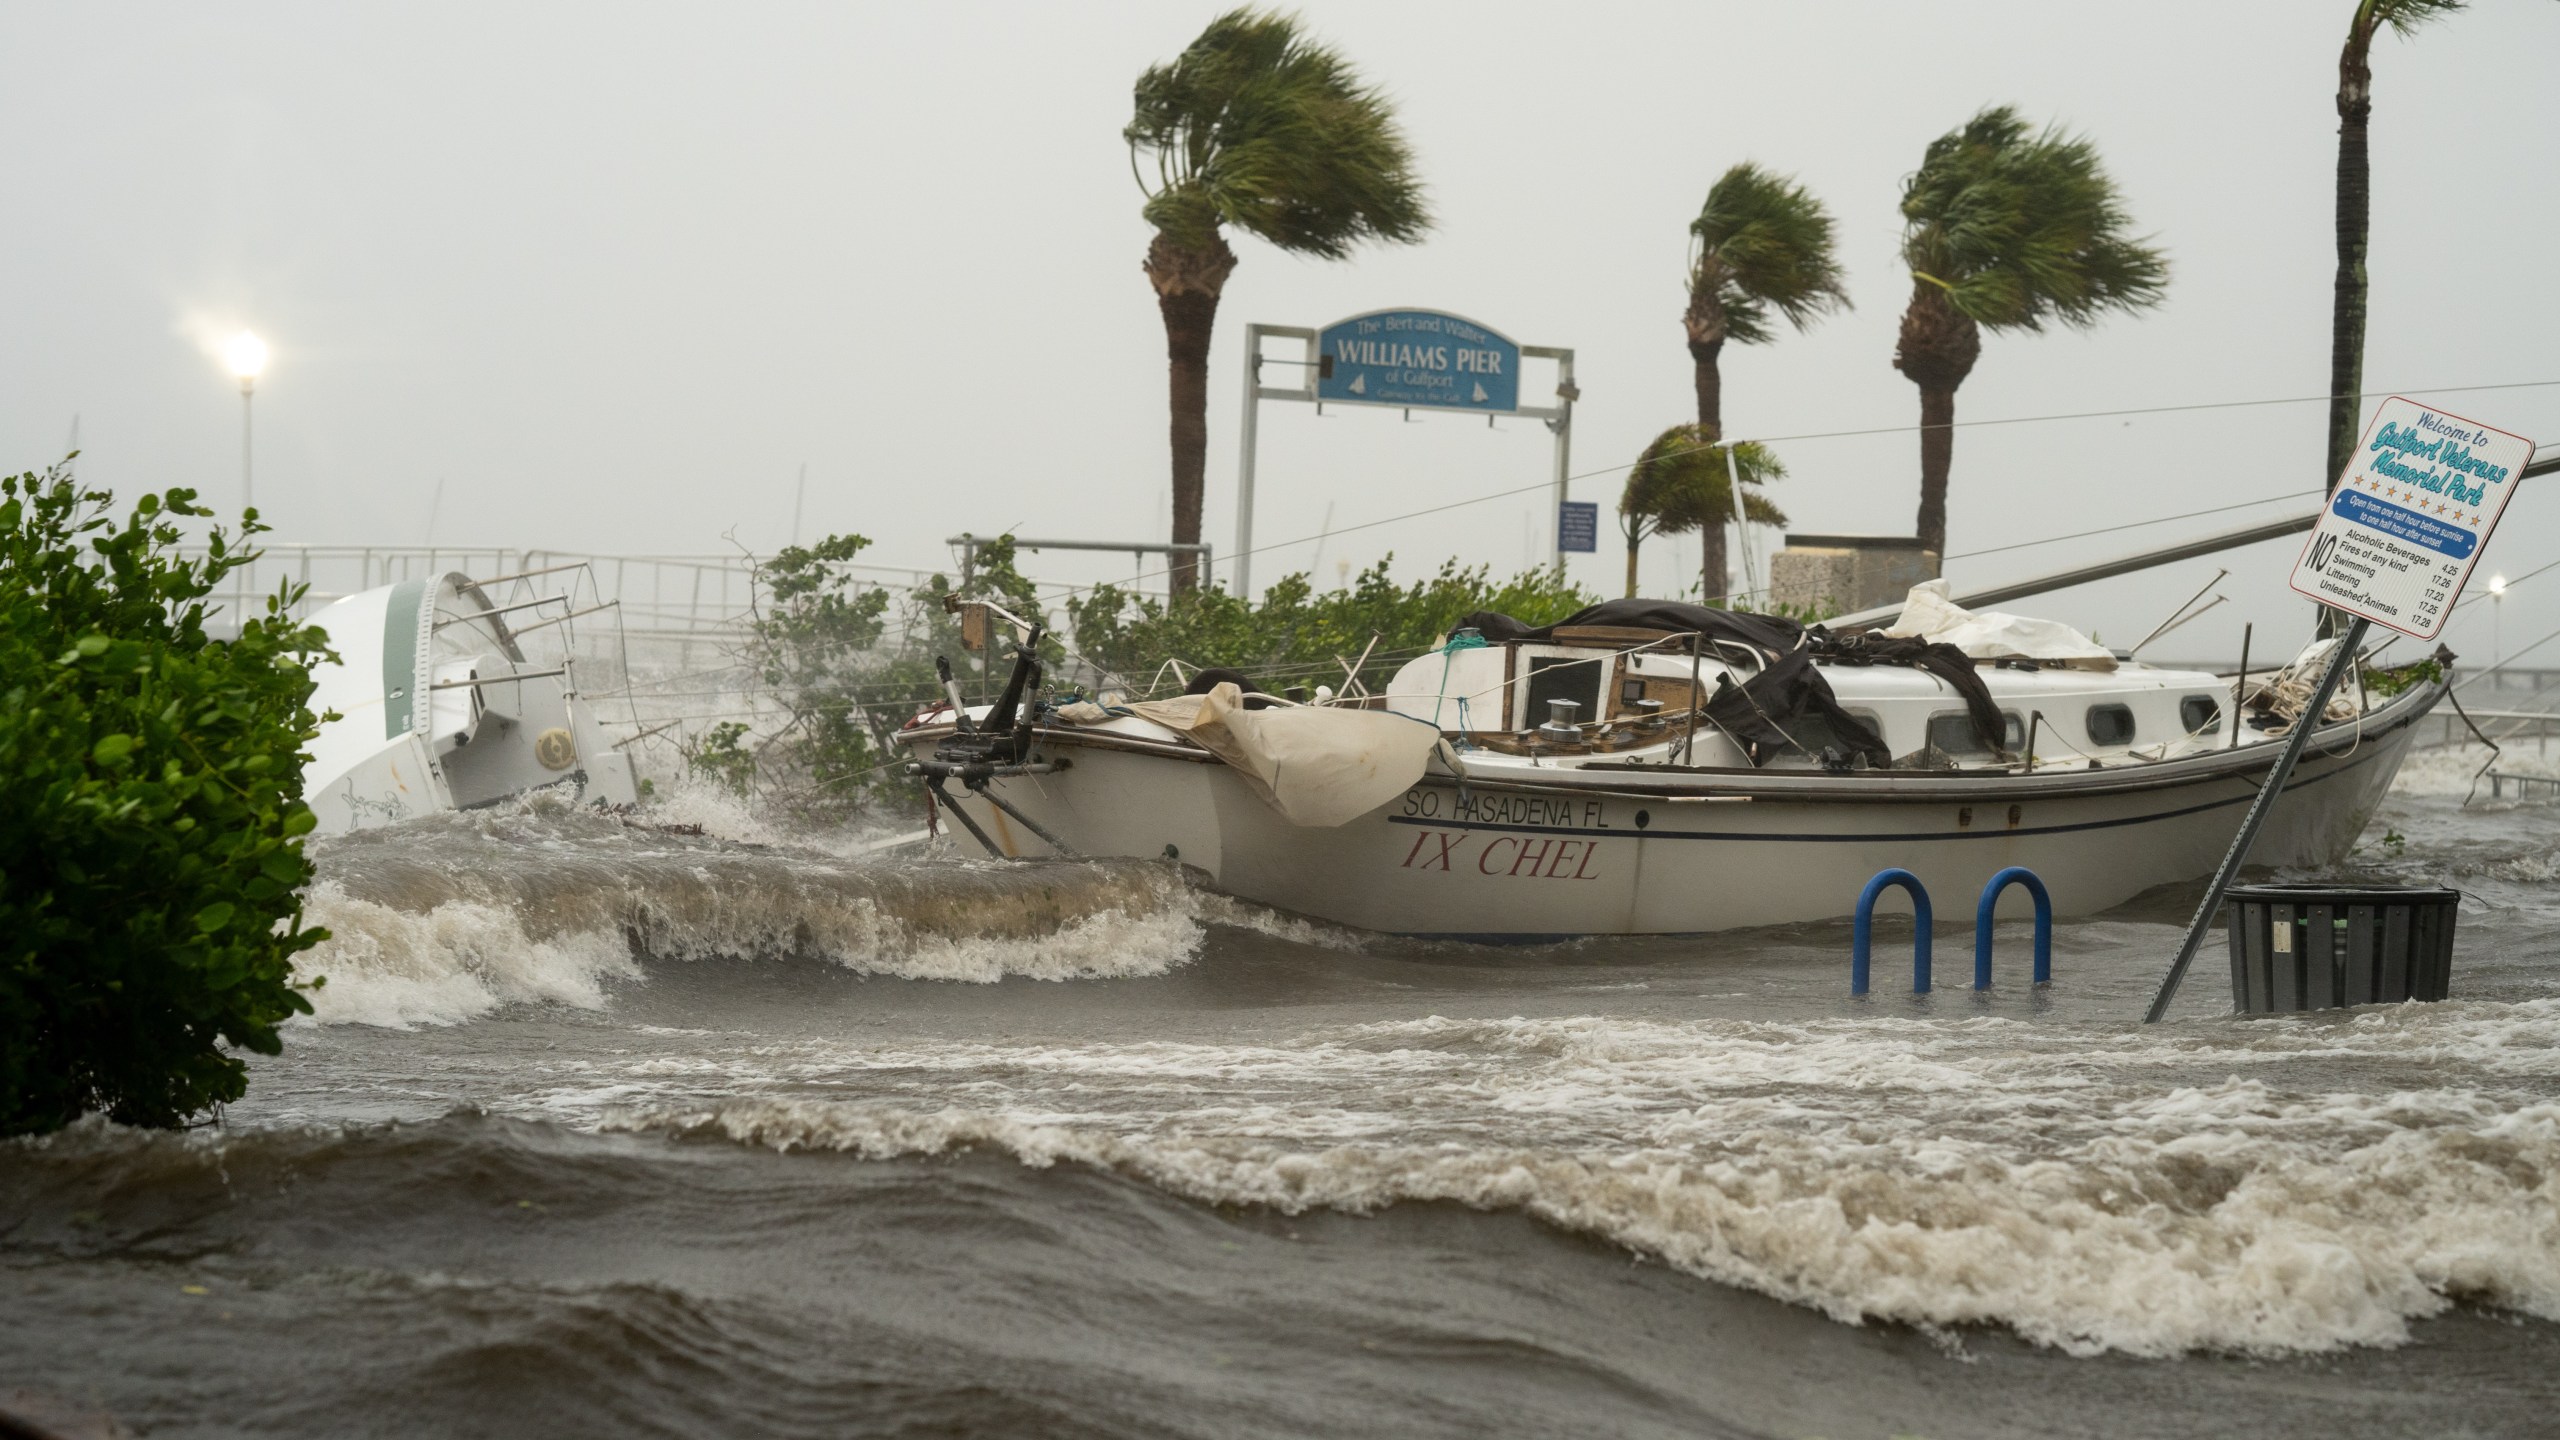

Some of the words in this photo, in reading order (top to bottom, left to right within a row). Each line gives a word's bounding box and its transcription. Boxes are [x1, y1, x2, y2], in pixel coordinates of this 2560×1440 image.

[1358, 320, 1380, 335] The
[1386, 317, 1412, 331] Bert
[1415, 319, 1440, 332] and
[1444, 321, 1486, 344] Walter
[1337, 338, 1448, 371] WILLIAMS
[1456, 348, 1502, 374] PIER
[1386, 369, 1399, 383] of
[1404, 369, 1453, 388] Gulfport
[2371, 421, 2444, 460] Gulfport
[2439, 441, 2508, 483] Veterans
[2417, 411, 2471, 441] Welcome
[2472, 430, 2488, 447] to
[2370, 450, 2451, 493] Memorial
[2444, 474, 2486, 506] Park
[2349, 495, 2366, 508] Open
[2366, 501, 2381, 513] from
[2381, 506, 2394, 517] one
[2393, 509, 2405, 521] half
[2405, 513, 2421, 526] hour
[2420, 517, 2441, 534] before
[2440, 527, 2464, 542] sunrise
[2360, 512, 2367, 521] to
[2367, 515, 2380, 526] one
[2379, 517, 2391, 530] half
[2391, 522, 2406, 534] hour
[2405, 527, 2421, 540] after
[2421, 533, 2442, 548] sunset
[2305, 531, 2337, 572] NO
[2339, 541, 2360, 556] Fires
[2361, 548, 2371, 558] of
[2371, 553, 2390, 567] any
[2389, 557, 2409, 573] kind
[2431, 575, 2452, 588] 17.26
[2346, 529, 2385, 550] Alcoholic
[2386, 543, 2431, 566] Beverages
[2442, 564, 2459, 576] 4.25
[2326, 567, 2361, 588] Littering
[2418, 601, 2439, 615] 17.25
[2333, 554, 2376, 578] Swimming
[2425, 588, 2445, 602] 17.23
[2320, 579, 2364, 602] Unleashed
[2364, 596, 2398, 616] Animals
[2411, 614, 2432, 628] 17.28
[1403, 790, 1441, 818] SO.
[1453, 794, 1572, 826] PASADENA
[1584, 801, 1609, 828] FL
[1400, 831, 1470, 871] IX
[1478, 837, 1601, 880] CHEL
